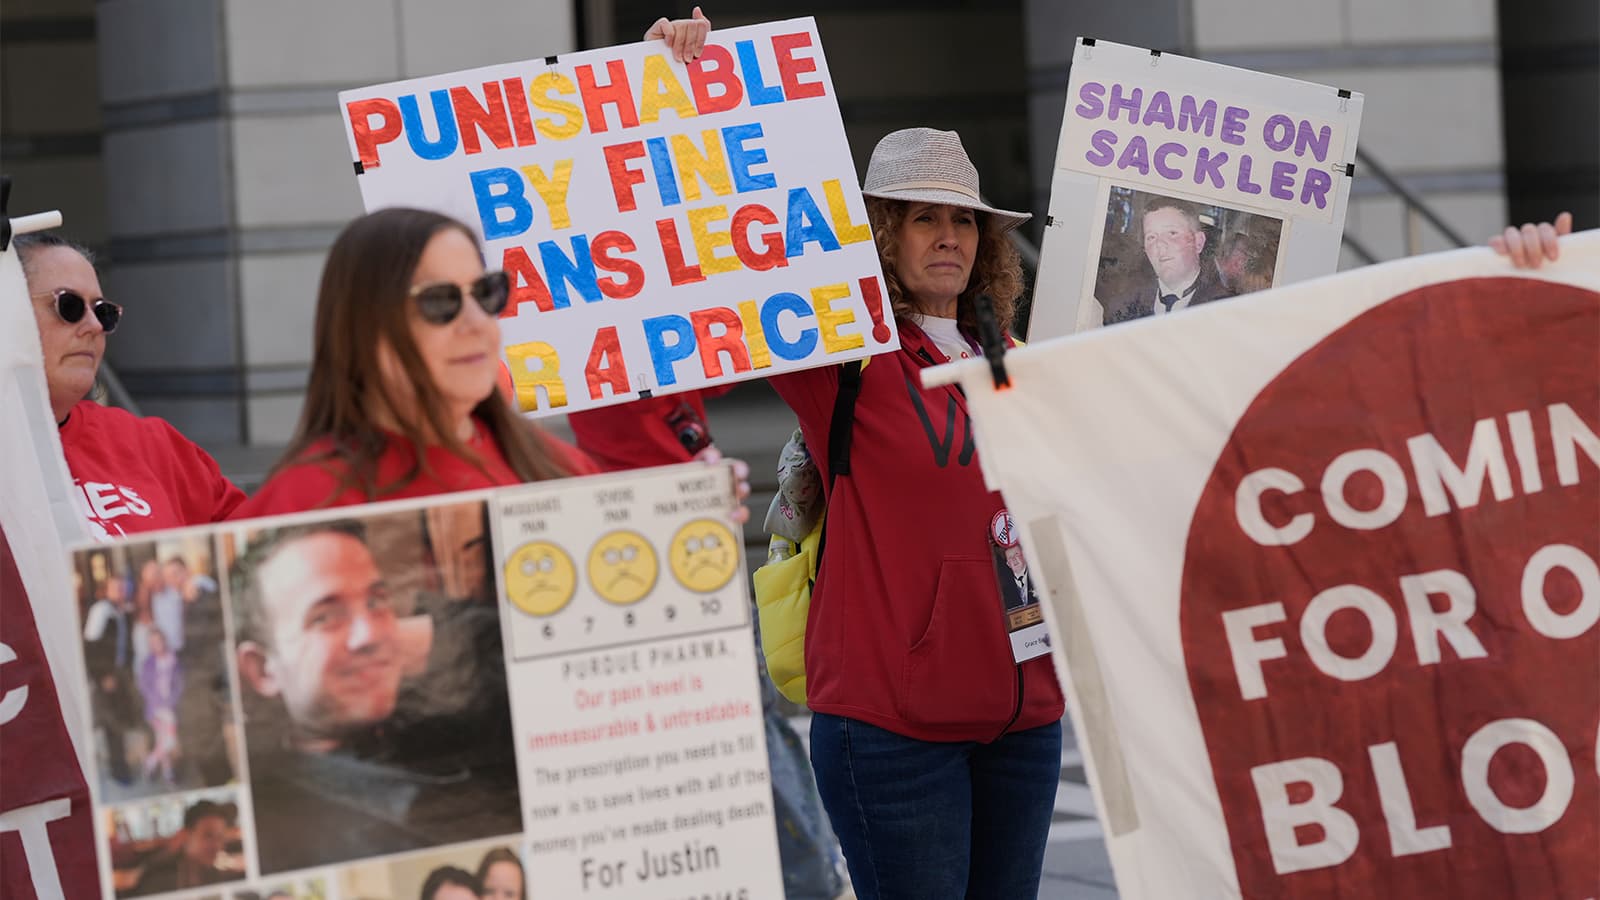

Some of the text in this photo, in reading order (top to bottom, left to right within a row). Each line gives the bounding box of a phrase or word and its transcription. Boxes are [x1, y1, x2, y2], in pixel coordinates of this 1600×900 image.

[346, 31, 826, 170] PUNISHABLE
[1075, 82, 1332, 162] SHAME ON
[469, 122, 777, 241] BY FINE
[1085, 129, 1332, 209] SACKLER
[499, 179, 871, 320] ANS LEGAL
[583, 326, 631, 400] A
[642, 276, 891, 386] PRICE!
[80, 481, 152, 519] ES
[541, 599, 721, 640] 6 7 8 9 10
[1222, 569, 1489, 700] FOR
[562, 651, 641, 679] PURDUE
[575, 675, 703, 710] Our pain level is
[528, 718, 638, 749] immeasurable
[645, 712, 656, 733] &
[534, 767, 560, 785] The
[565, 755, 650, 784] prescription
[655, 752, 679, 771] you
[684, 743, 716, 761] need
[719, 741, 734, 755] to
[531, 806, 560, 820] now
[639, 785, 671, 802] lives
[675, 778, 702, 796] with
[707, 775, 722, 790] all
[729, 771, 743, 786] of
[1251, 718, 1600, 875] BLO
[531, 838, 577, 856] money
[632, 820, 668, 837] made
[672, 808, 725, 831] dealing
[580, 840, 721, 892] For Justin
